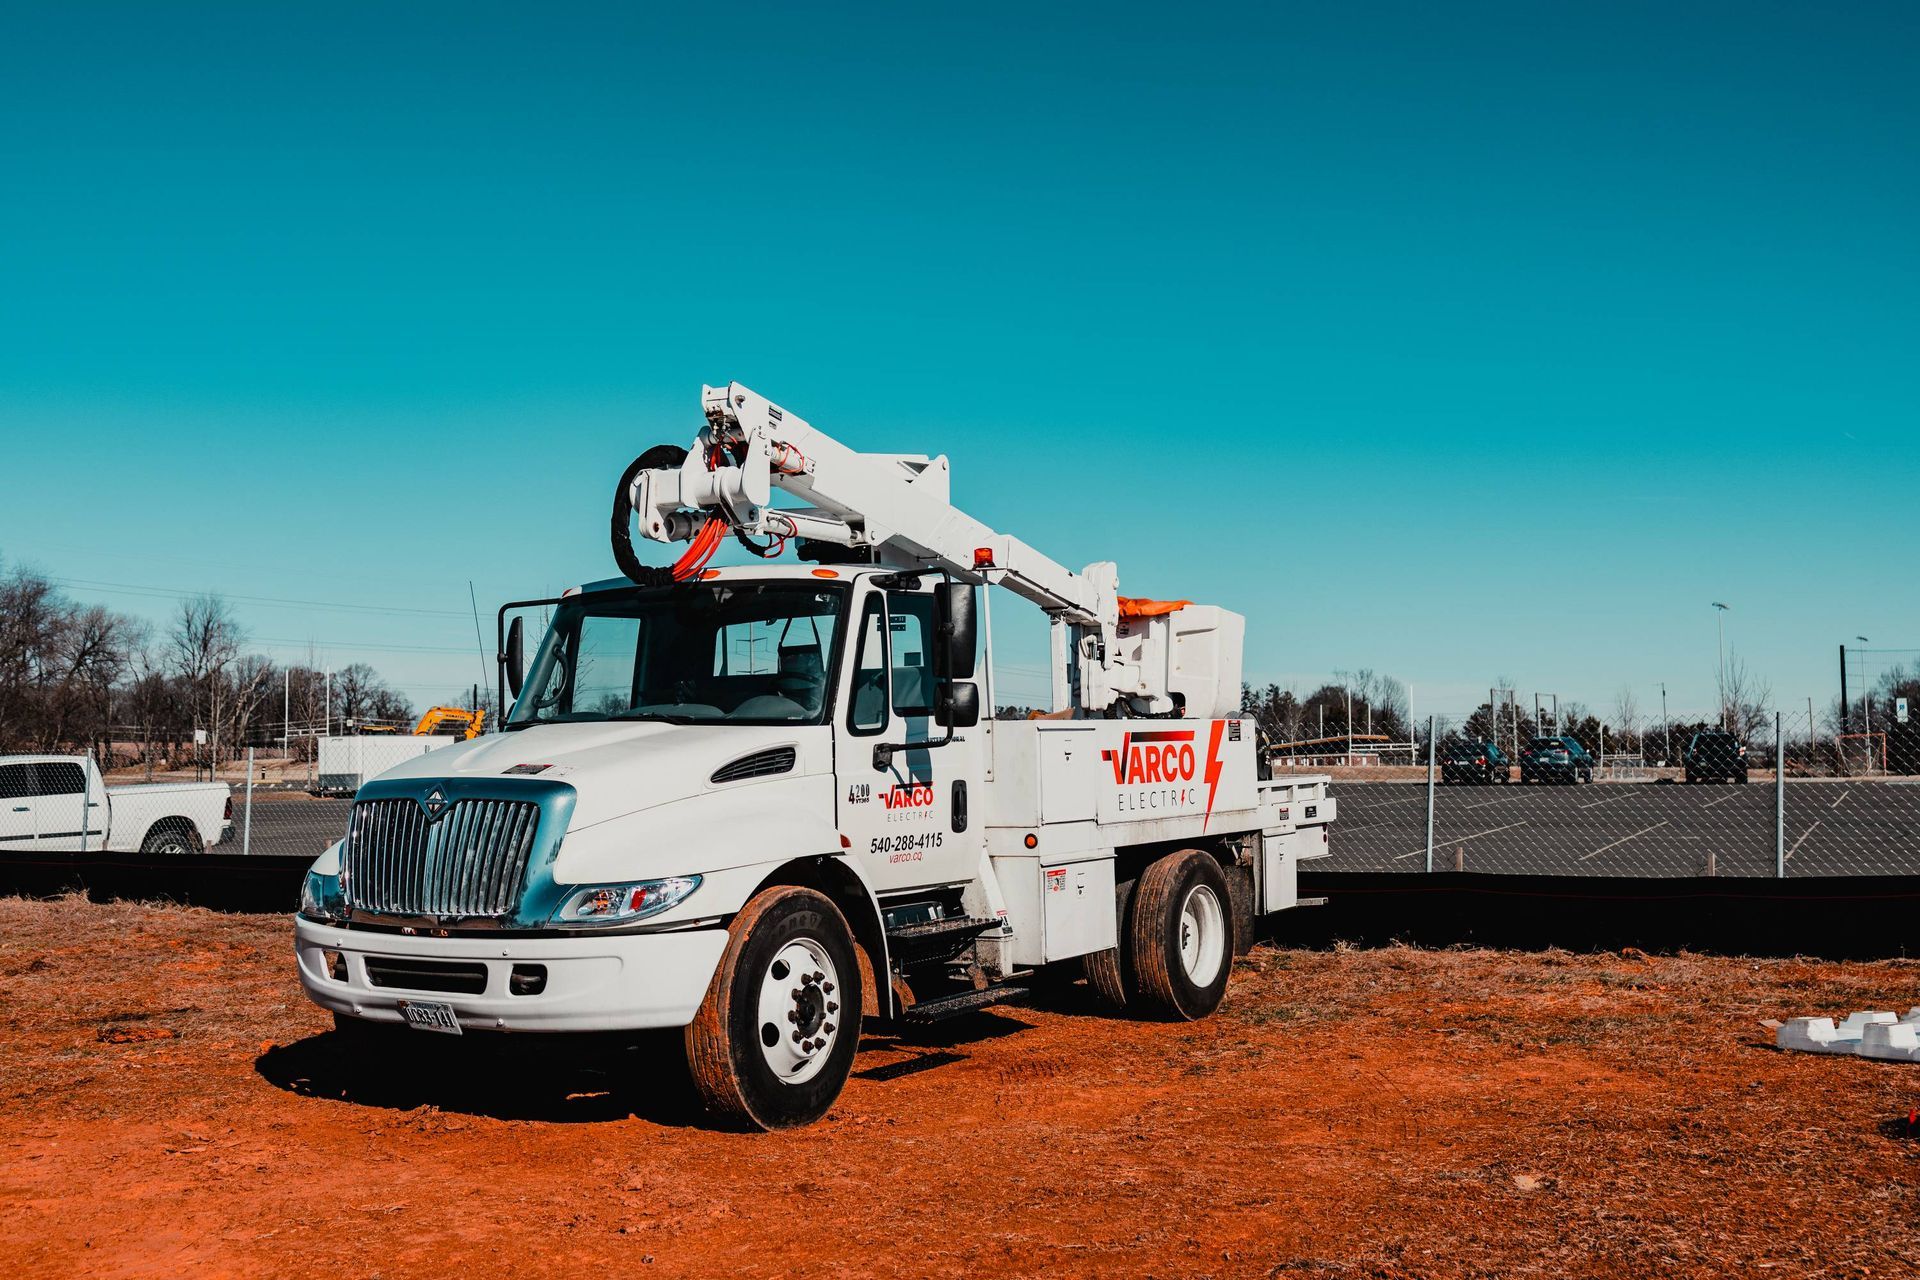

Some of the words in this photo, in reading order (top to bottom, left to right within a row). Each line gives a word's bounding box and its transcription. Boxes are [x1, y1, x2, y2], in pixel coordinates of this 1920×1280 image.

[1101, 731, 1195, 785] VARCO
[848, 784, 870, 804] 4200
[878, 782, 933, 809] VARCO
[1118, 788, 1196, 811] ELECTRIC
[887, 811, 934, 822] ELECTRIC
[870, 832, 943, 854] 540-288-4115
